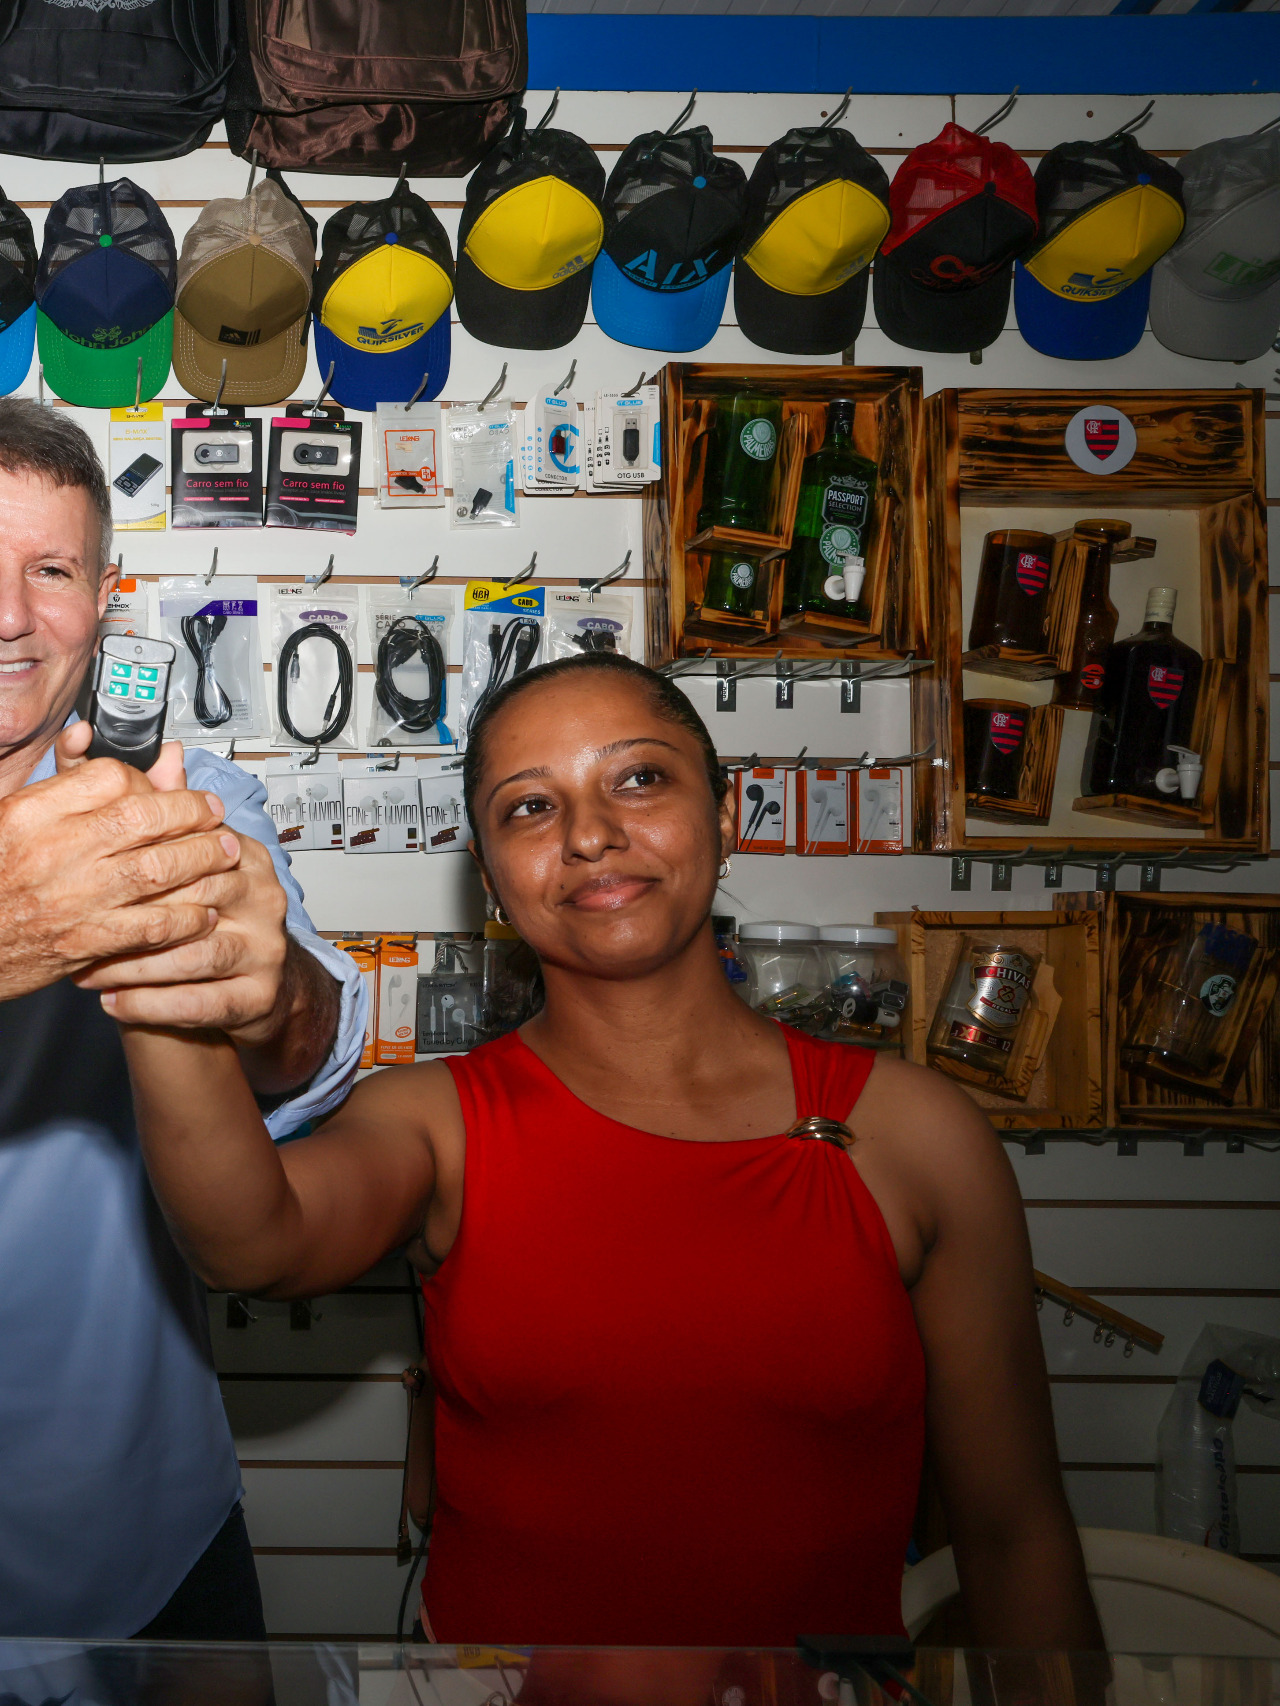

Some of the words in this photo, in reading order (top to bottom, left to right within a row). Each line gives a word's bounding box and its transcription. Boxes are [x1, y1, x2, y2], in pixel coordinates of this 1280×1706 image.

[551, 262, 589, 280] adidas
[61, 326, 106, 350] John
[112, 322, 154, 348] John
[356, 325, 426, 346] QUIKSILVER
[545, 473, 568, 481] CONECTOR
[186, 479, 212, 488] Carro
[214, 480, 234, 488] sem
[235, 479, 250, 488] fio
[282, 479, 309, 489] Carro
[310, 482, 330, 490] sem
[332, 481, 345, 491] fio
[827, 489, 865, 506] PASSPORT
[828, 500, 862, 512] SELECTION
[517, 598, 533, 607] CABO
[308, 614, 339, 623] CABO
[375, 612, 398, 621] SÉRIE
[586, 622, 615, 631] CABO
[271, 802, 294, 824] FONE
[309, 800, 342, 822] OUVIDO
[346, 806, 369, 826] FONE
[384, 804, 418, 825] OUVIDO
[426, 806, 448, 826] FONE
[985, 967, 1032, 990] CHIVAS
[991, 1003, 1012, 1014] REGAL
[423, 1038, 445, 1046] Tuned
[446, 1038, 455, 1047] by
[1001, 1040, 1011, 1052] 12
